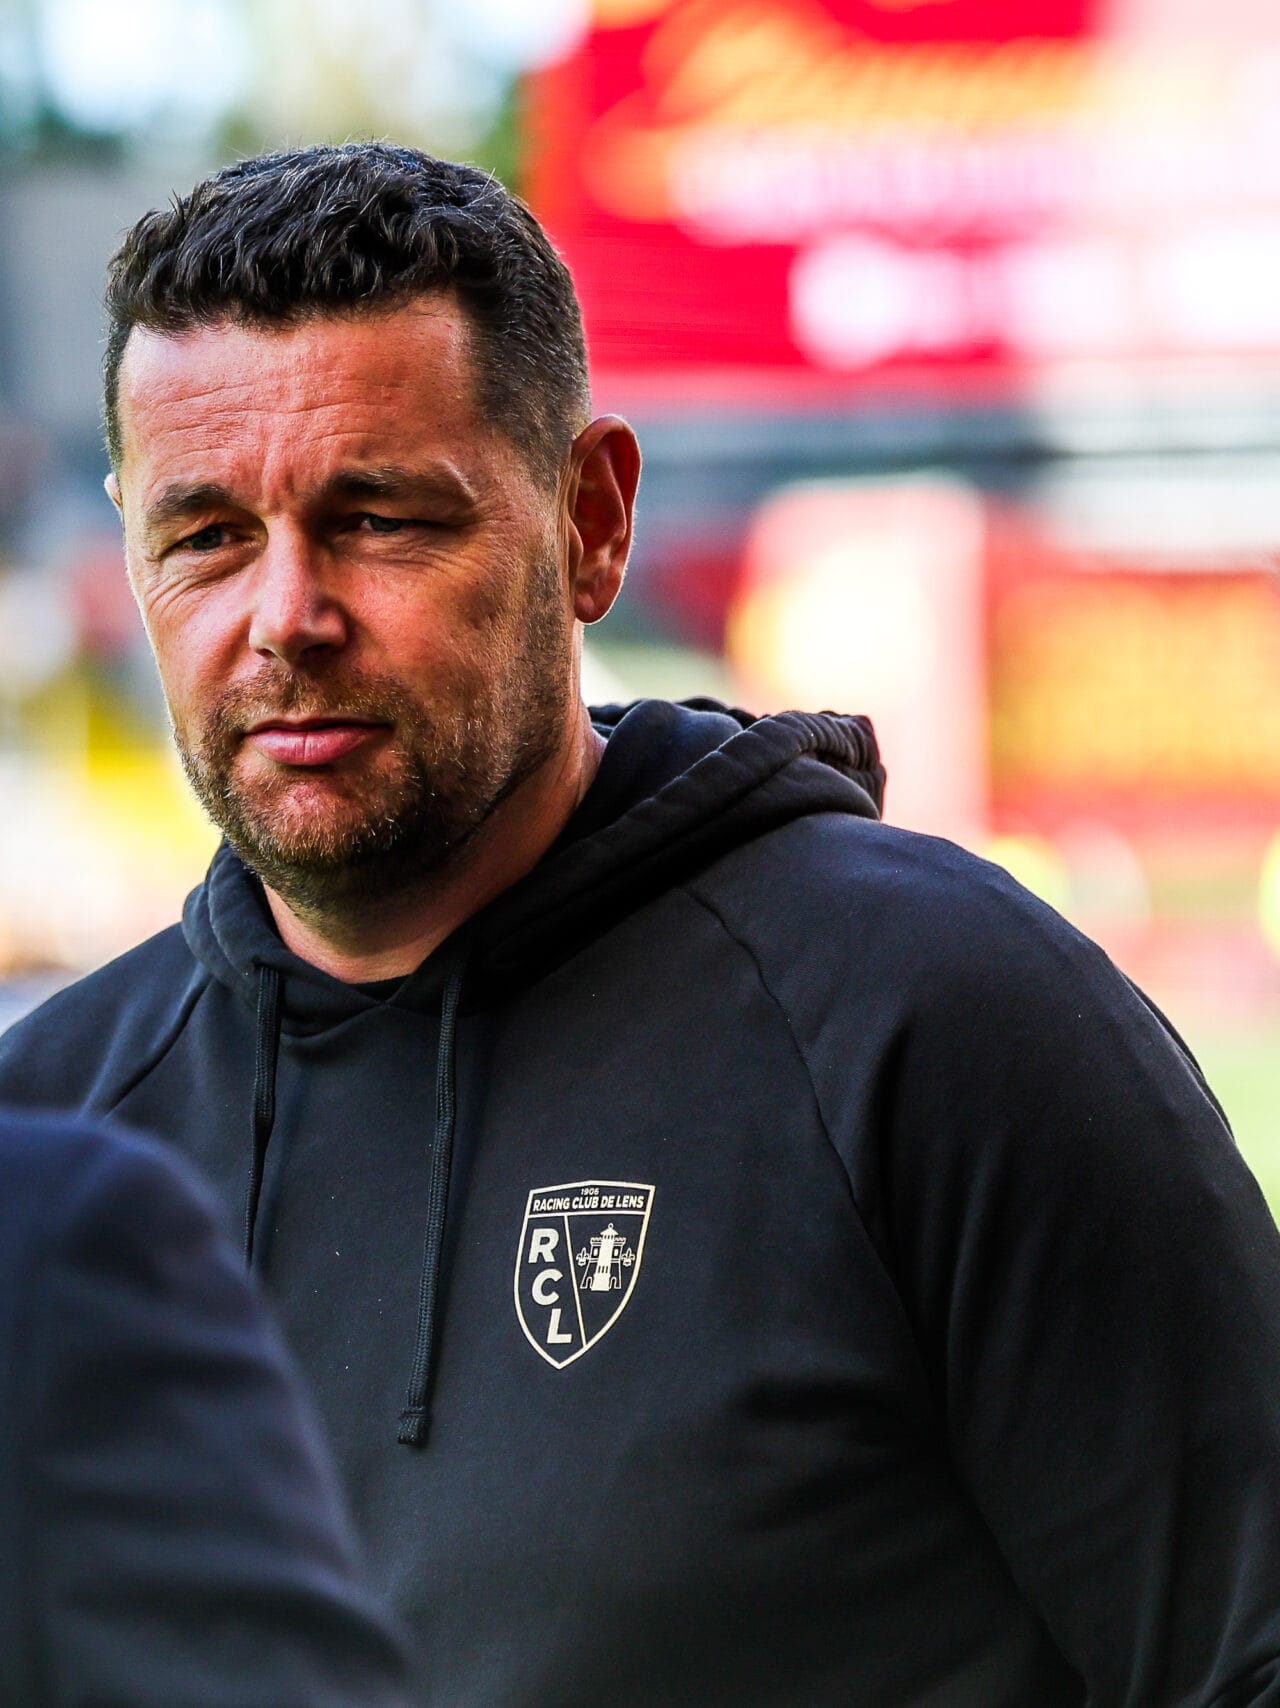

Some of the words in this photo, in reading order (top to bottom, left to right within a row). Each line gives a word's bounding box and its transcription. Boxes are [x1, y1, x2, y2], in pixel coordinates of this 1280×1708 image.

[580, 1187, 600, 1196] 1906
[532, 1199, 570, 1212] RACING
[571, 1196, 599, 1209] CLUB
[600, 1196, 617, 1208] DE
[617, 1195, 644, 1209] LENS
